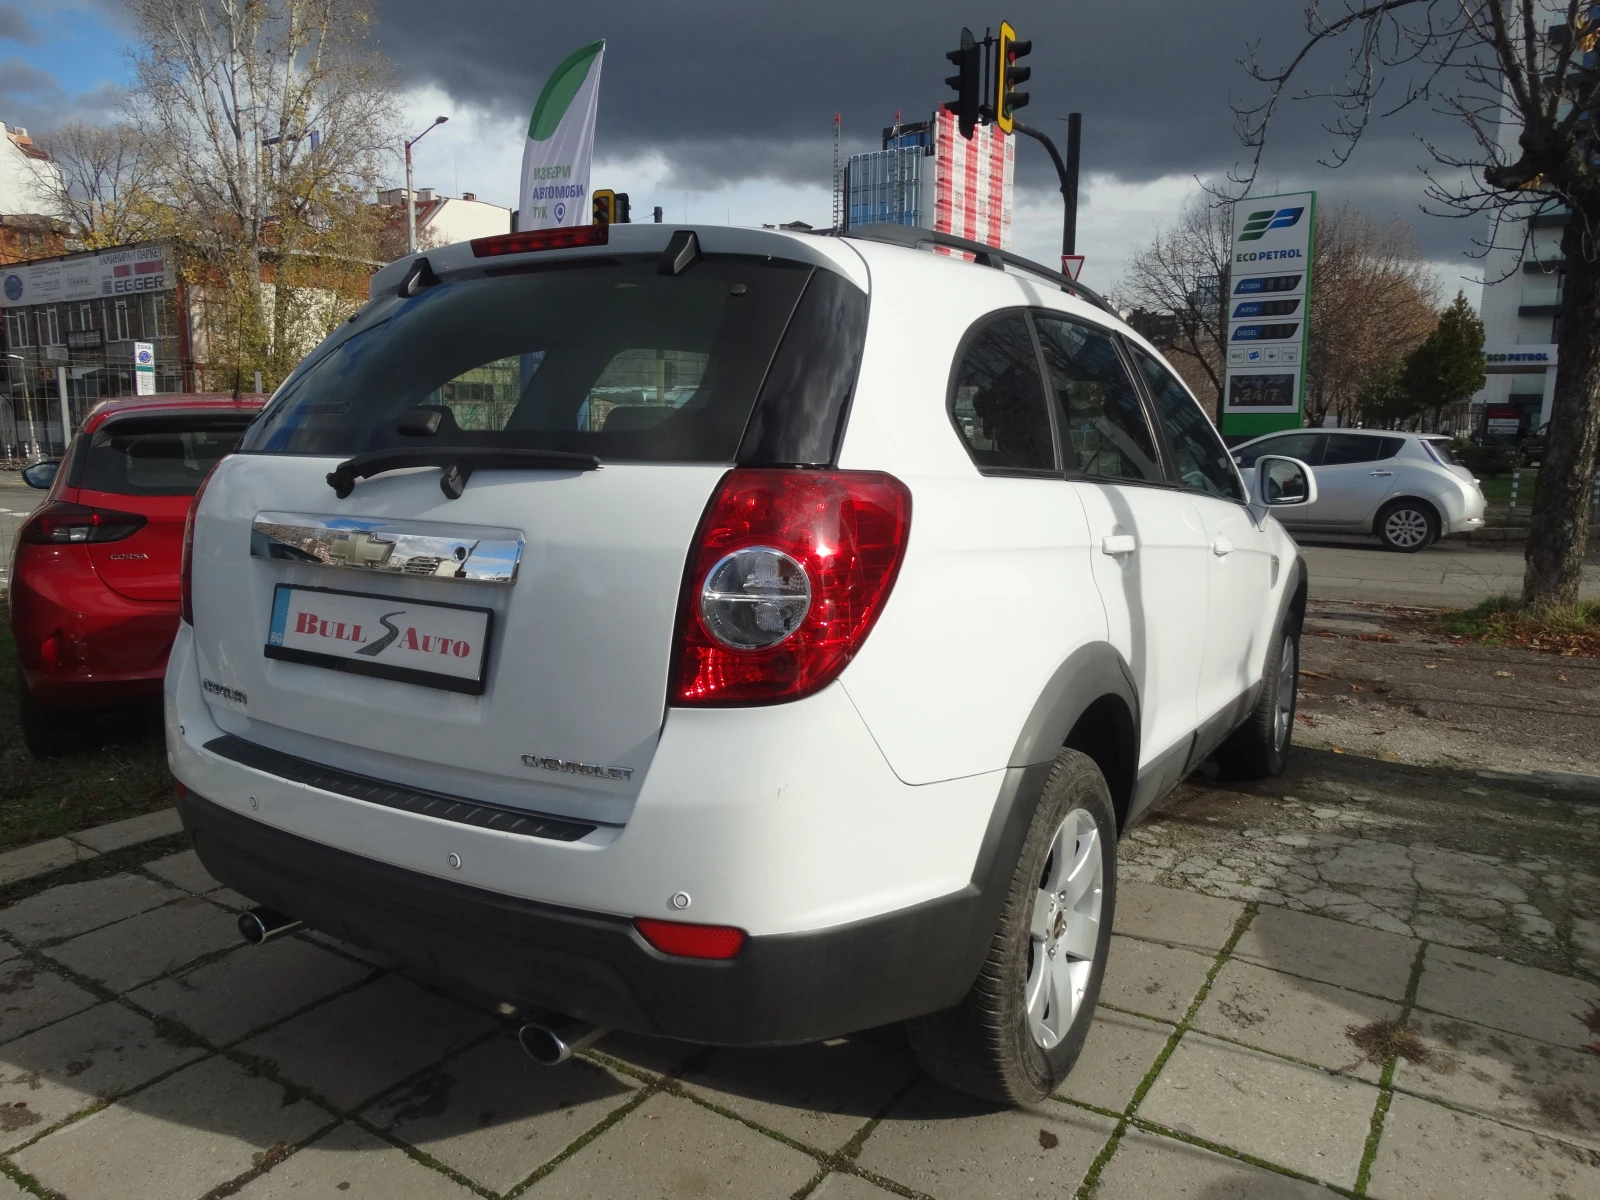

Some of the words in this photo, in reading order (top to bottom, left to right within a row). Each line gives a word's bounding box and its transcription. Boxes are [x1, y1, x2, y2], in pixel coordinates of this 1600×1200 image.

[533, 165, 572, 180] ИЗБЕРИ
[533, 206, 548, 220] ТУК
[1236, 252, 1257, 263] ECO
[1258, 248, 1302, 261] PETROL
[115, 275, 165, 293] EGGER
[1237, 329, 1257, 337] DIESEL
[1487, 353, 1506, 361] ECO
[1507, 353, 1548, 361] PETROL
[1241, 387, 1280, 401] 24/7
[270, 632, 283, 643] BG
[294, 611, 367, 643] BULL
[397, 626, 470, 658] AUTO
[521, 754, 634, 781] CHEVROLET
